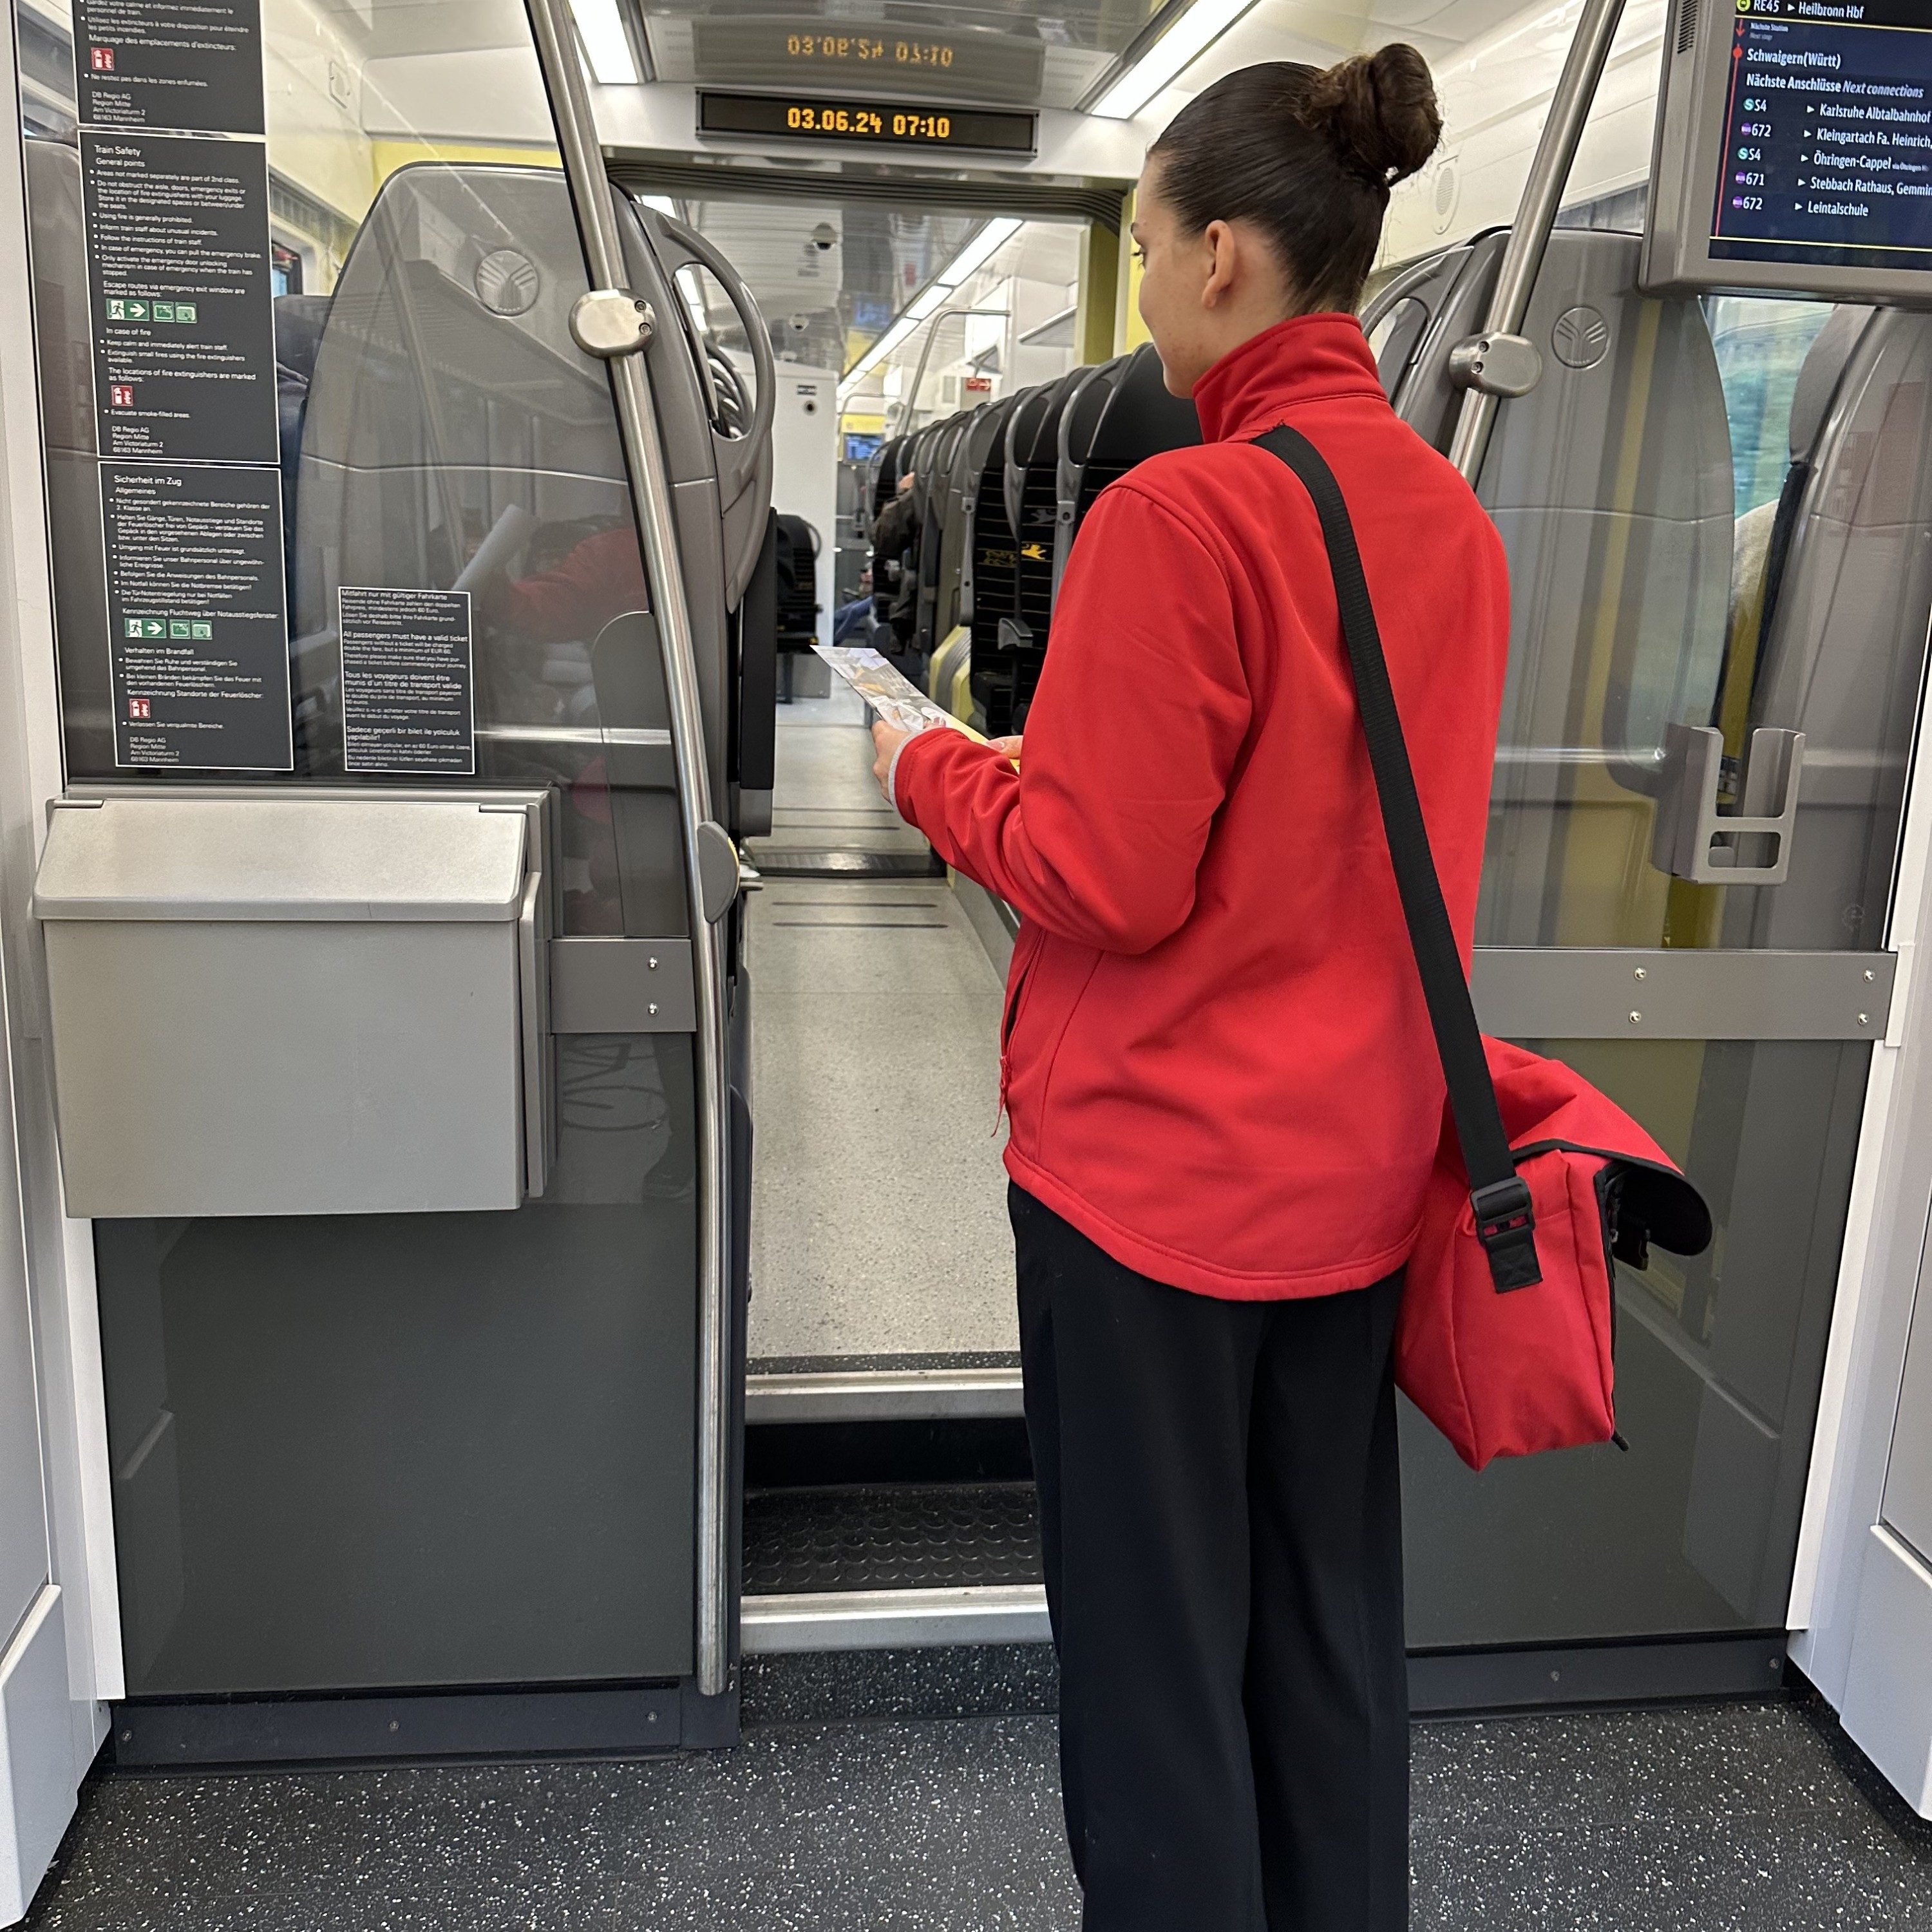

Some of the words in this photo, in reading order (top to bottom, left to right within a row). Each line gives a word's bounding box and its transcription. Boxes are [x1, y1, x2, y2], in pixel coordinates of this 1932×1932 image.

[1754, 0, 1779, 13] RE45
[1799, 1, 1844, 17] Heilbronn
[1846, 5, 1864, 19] Hbf
[1747, 48, 1841, 70] Schwaigern(Württ)
[1747, 73, 1786, 88] Nächste
[1788, 76, 1841, 93] Anschlüsse
[1842, 80, 1866, 94] Next
[1867, 84, 1924, 99] connections
[787, 107, 883, 134] 03.06.24
[893, 114, 951, 138] 07:10
[1754, 99, 1767, 112] S4
[1820, 104, 1864, 119] Karlsruhe
[1866, 106, 1931, 124] Albtalbahnhof
[1752, 123, 1771, 137] 672
[1817, 128, 1875, 145] Kleingartach
[1877, 133, 1890, 146] Fa.
[1892, 135, 1932, 150] Heinrich,
[95, 145, 113, 155] Train
[115, 146, 140, 158] Safety
[1748, 148, 1761, 161] S4
[1814, 149, 1891, 172] Öhringen-Cappel
[124, 159, 145, 168] points
[1746, 173, 1765, 186] 671
[1810, 177, 1853, 192] Stebbach
[1855, 179, 1895, 196] Rathaus,
[1743, 196, 1763, 210] 672
[1808, 200, 1868, 217] Leintalschule
[114, 475, 153, 484] Sicherheit
[154, 477, 164, 485] im
[166, 477, 182, 487] Zug
